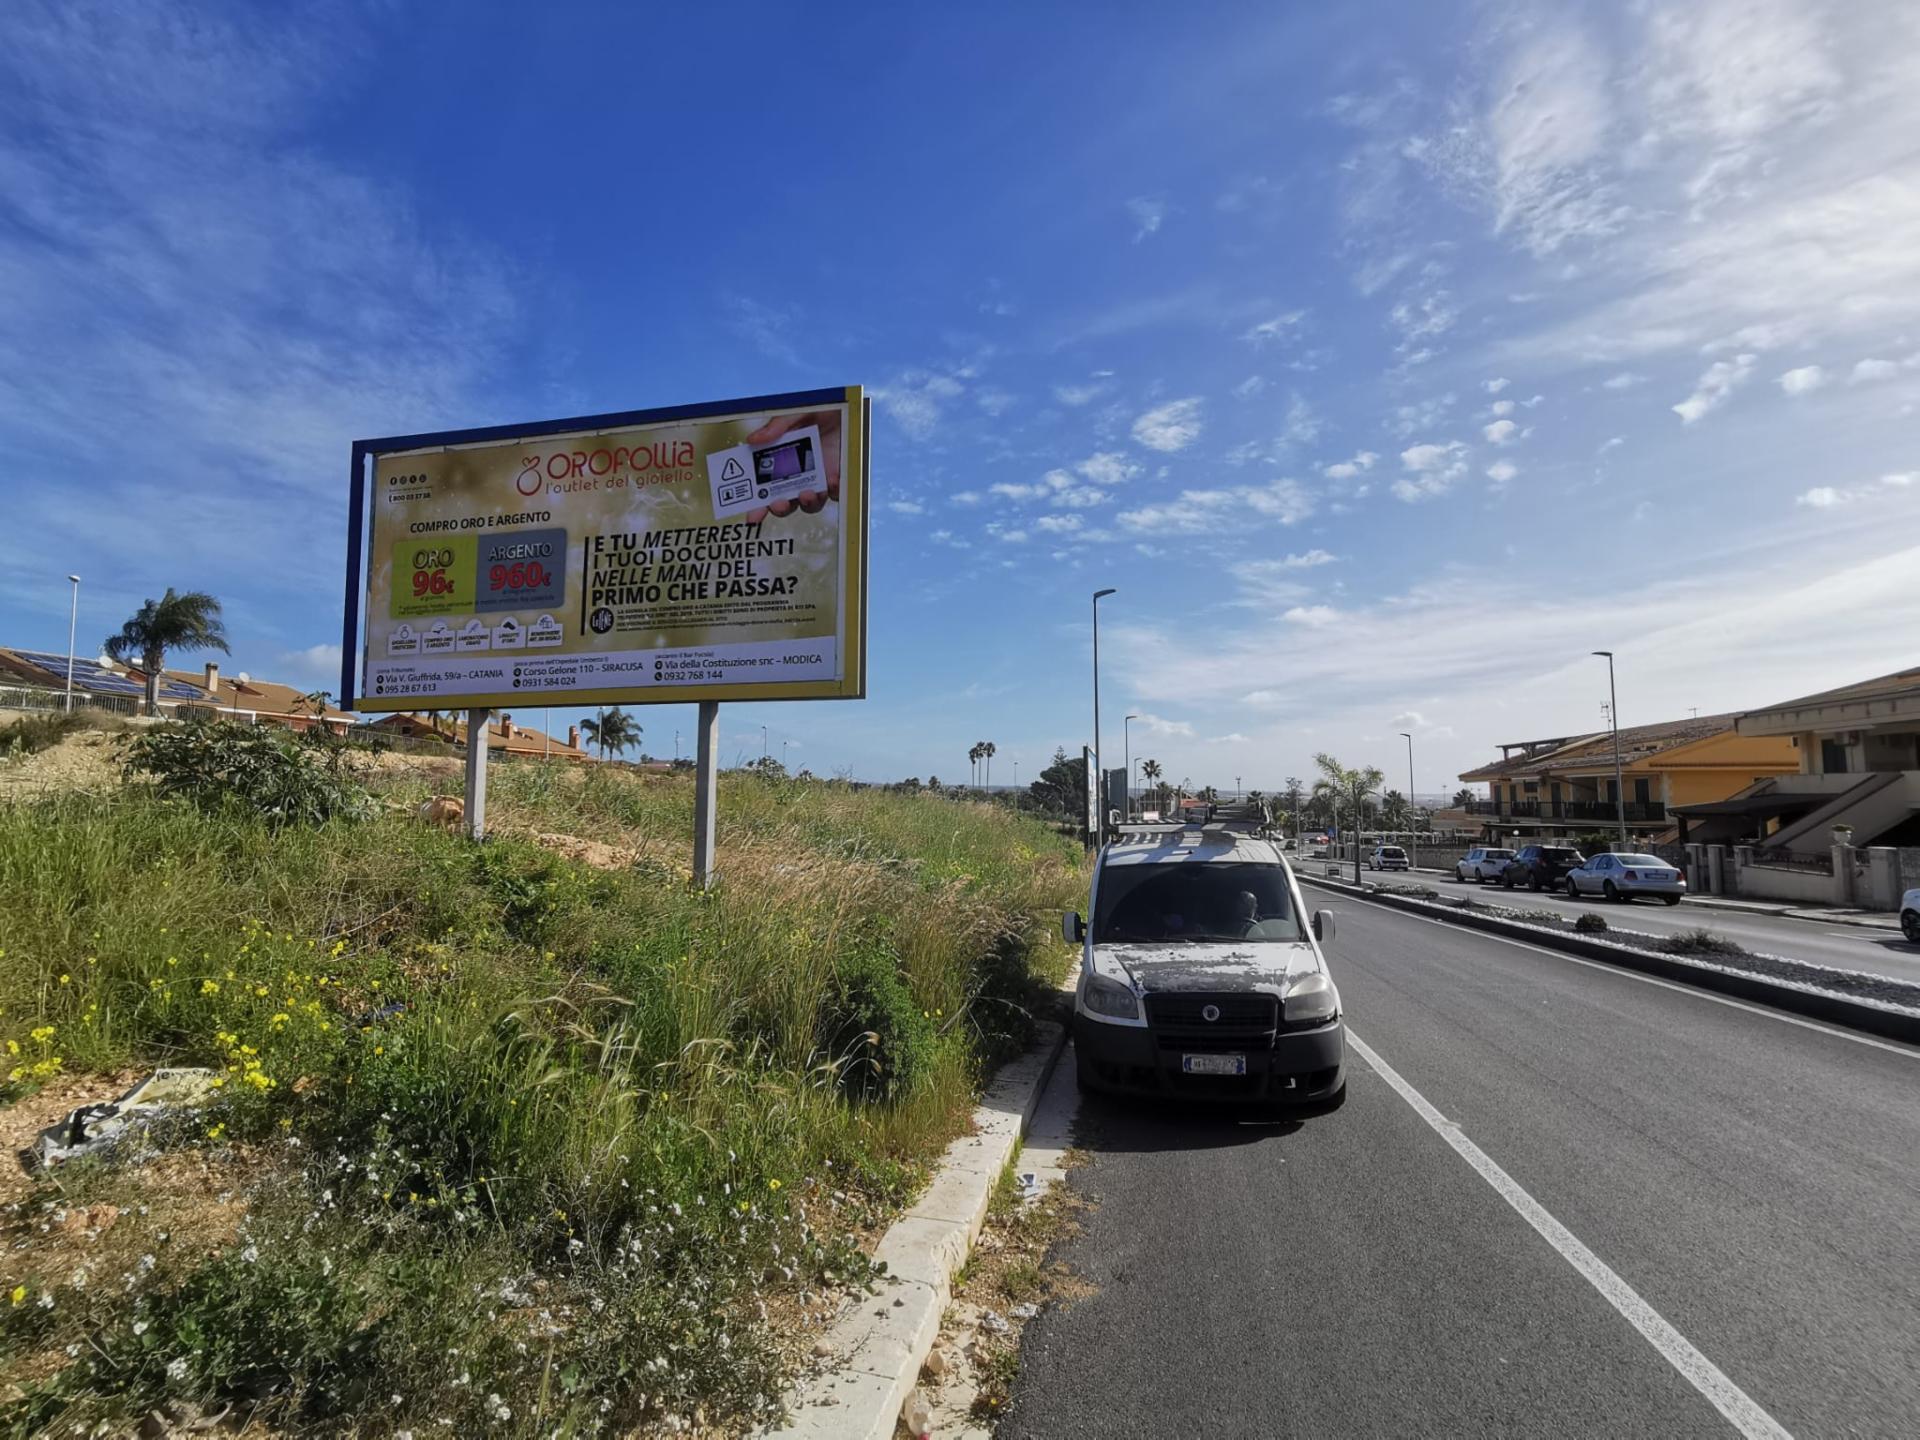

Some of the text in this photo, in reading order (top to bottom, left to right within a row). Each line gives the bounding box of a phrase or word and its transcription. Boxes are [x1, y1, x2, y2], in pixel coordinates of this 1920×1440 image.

[545, 469, 693, 494] l'outlet del gioiello
[410, 511, 551, 533] COMPRO ORO E ARGENTO
[595, 522, 762, 552] E TU METTERESTI
[413, 548, 454, 569] ORO
[488, 543, 553, 562] ARGENTO
[594, 539, 794, 569] I TUOI DOCUMENTI
[413, 569, 454, 596] 96€
[489, 561, 552, 590] 960€
[592, 560, 757, 588] NELLE MANI DEL
[592, 576, 798, 606] PRIMO CHE PASSA?
[523, 667, 547, 676] Corso
[548, 666, 577, 675] Gelone
[579, 665, 593, 673] 110
[601, 662, 643, 672] SIRACUSA
[665, 661, 678, 669] Via
[680, 659, 700, 669] della
[702, 658, 756, 668] Costituzione
[782, 654, 822, 664] MODICA
[386, 675, 397, 683] Via
[399, 674, 406, 682] V.
[445, 671, 461, 680] 59/a
[469, 669, 504, 679] CATANIA
[522, 677, 576, 687] 0931 584 024
[664, 670, 722, 681] 0932 768 144
[385, 683, 436, 694] 095 28 67 613
